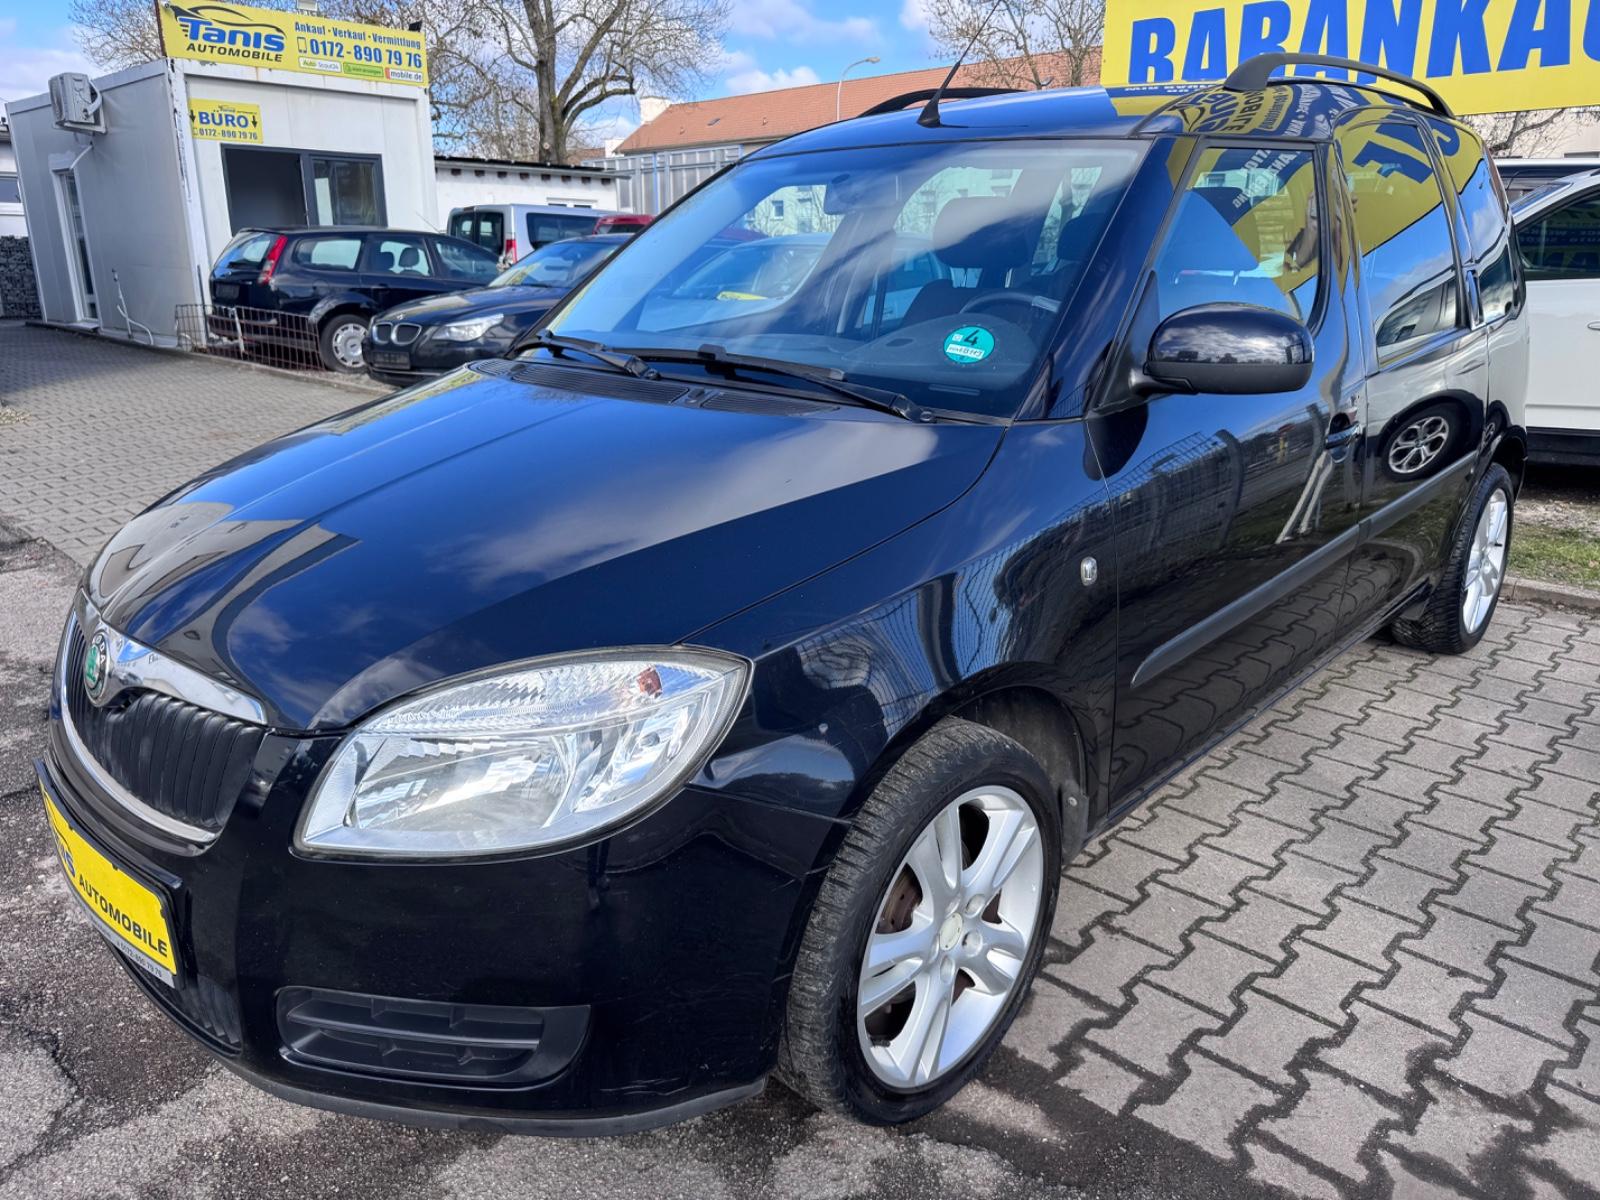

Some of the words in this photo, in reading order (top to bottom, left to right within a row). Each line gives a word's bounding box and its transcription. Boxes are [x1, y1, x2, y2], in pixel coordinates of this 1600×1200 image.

[177, 17, 285, 53] Tanis
[295, 22, 325, 36] Ankauf
[332, 27, 366, 41] Verkauf
[372, 33, 421, 50] Vermittlung
[186, 43, 283, 62] AUTOMOBILE
[385, 49, 403, 66] 79
[405, 52, 423, 69] 76
[198, 109, 249, 128] BÜRO
[964, 329, 980, 346] 4
[79, 874, 168, 957] AUTOMOBILE
